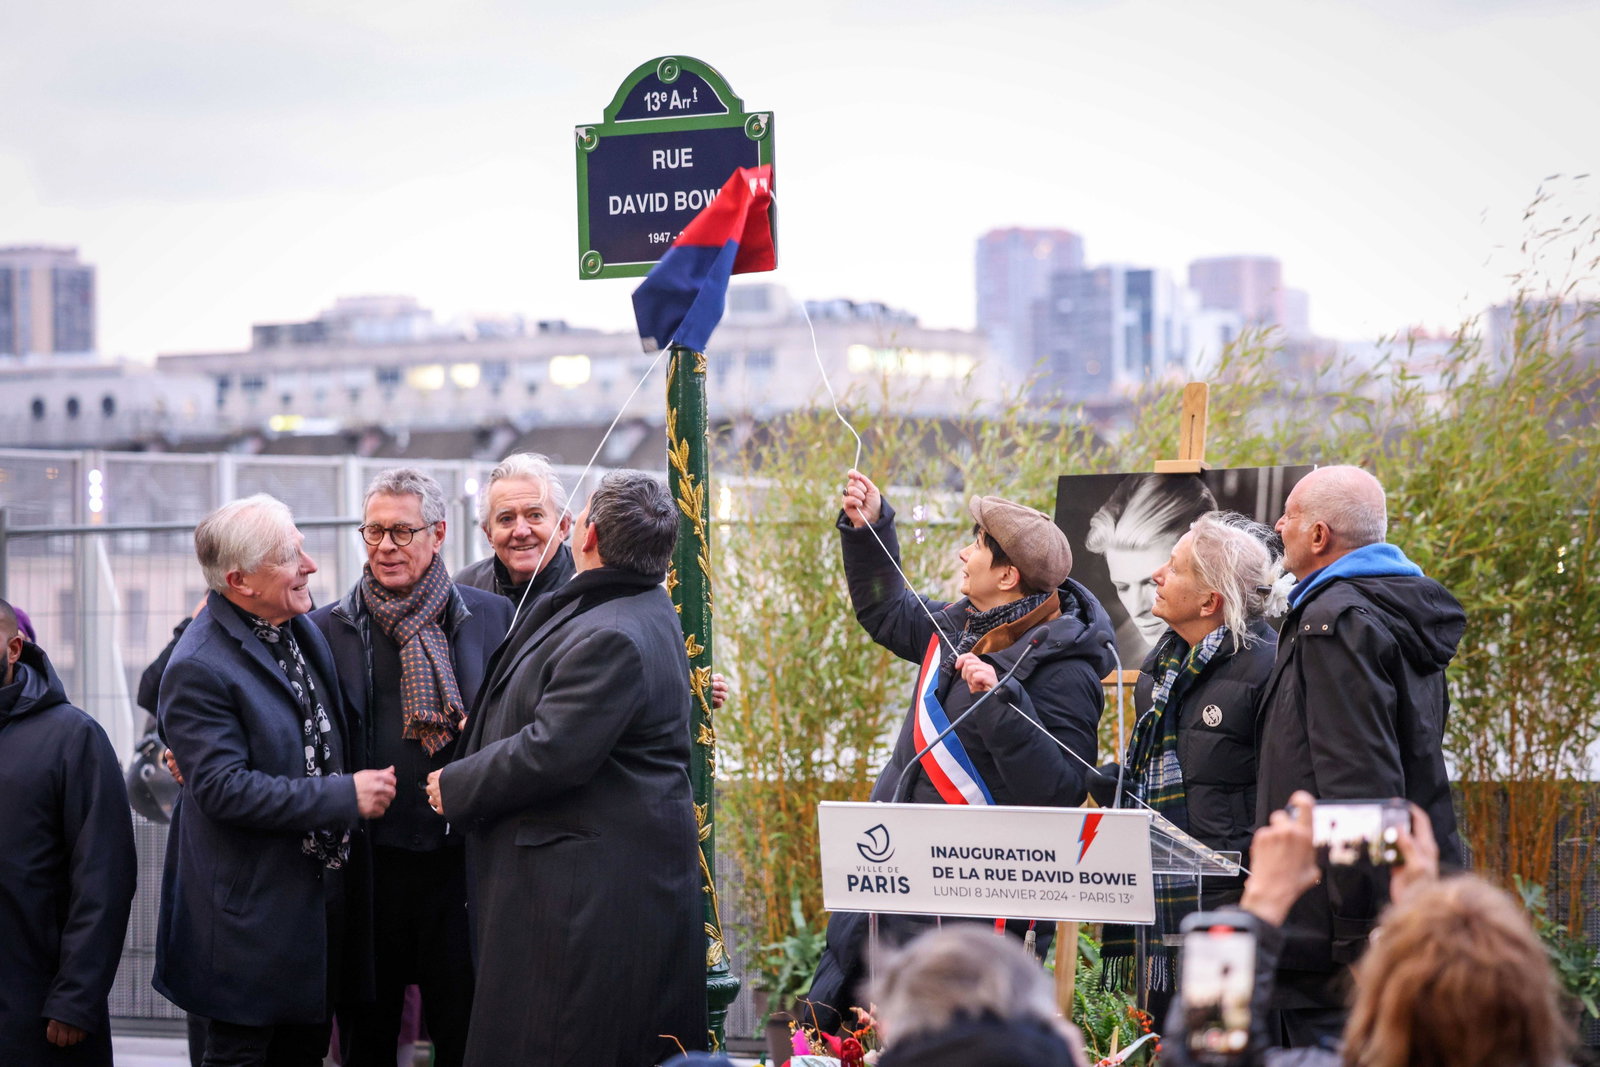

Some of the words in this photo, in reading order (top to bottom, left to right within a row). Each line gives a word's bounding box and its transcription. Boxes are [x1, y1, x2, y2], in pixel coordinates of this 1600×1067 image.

[652, 148, 694, 170] RUE
[608, 192, 669, 215] DAVID
[674, 188, 722, 211] BOW
[648, 232, 671, 244] 1947
[931, 846, 1056, 862] INAUGURATION
[856, 865, 883, 873] VILLE
[932, 866, 955, 879] DE
[959, 867, 980, 880] LA
[984, 868, 1017, 882] RUE
[1022, 869, 1074, 884] DAVID
[1079, 872, 1137, 886] BOWIE
[847, 874, 910, 894] PARIS
[933, 886, 972, 897] LUNDI
[975, 887, 983, 898] 8
[985, 888, 1037, 900] JANVIER
[1040, 890, 1068, 901] 2024
[1080, 891, 1116, 904] PARIS
